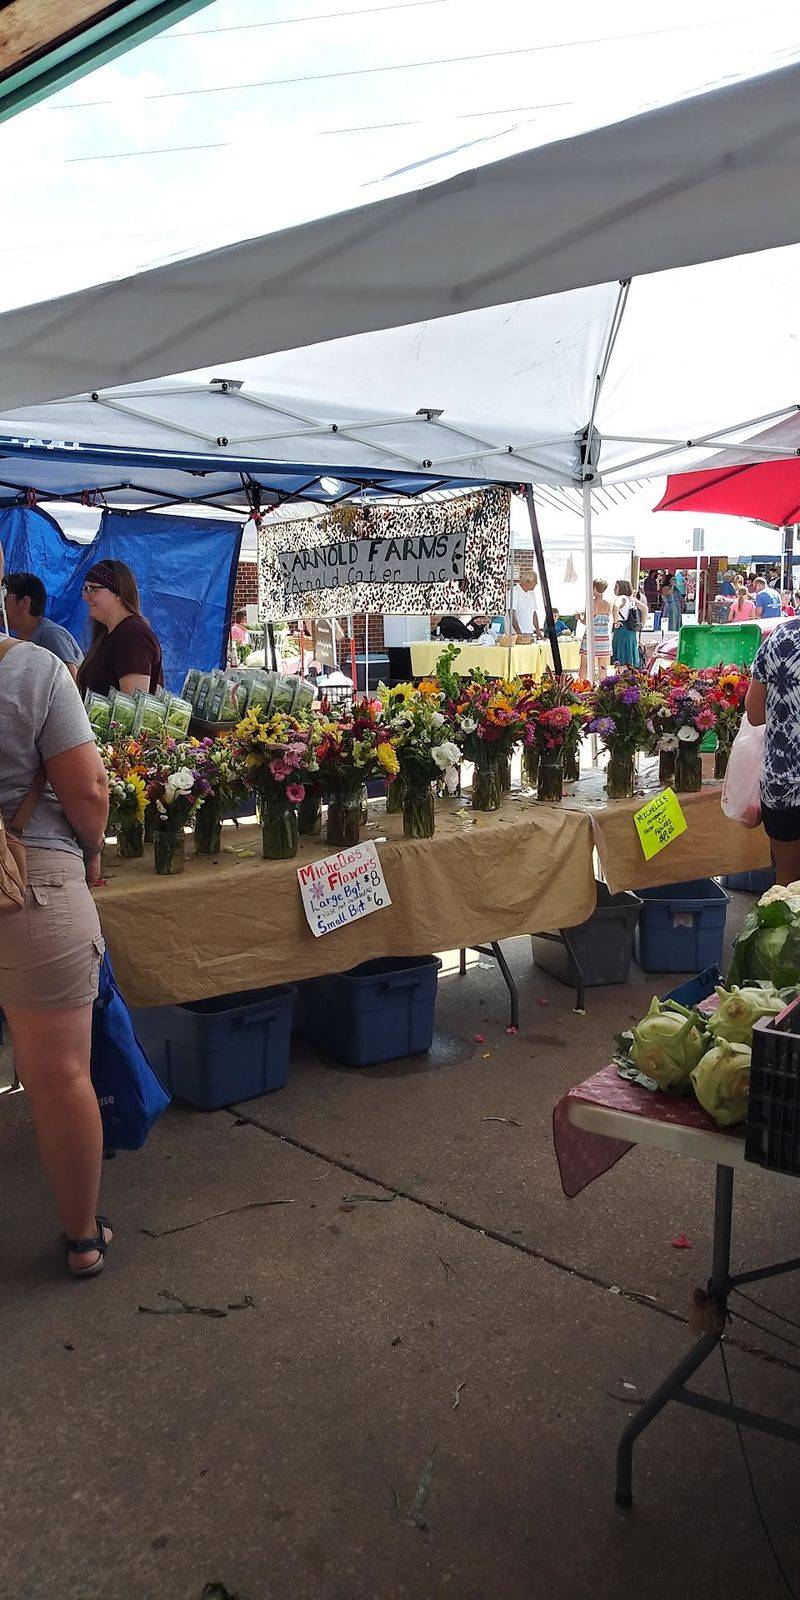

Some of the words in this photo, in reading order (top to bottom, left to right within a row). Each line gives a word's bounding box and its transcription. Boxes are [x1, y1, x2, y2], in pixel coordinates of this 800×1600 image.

[291, 542, 359, 572] ARNOLD
[368, 535, 449, 562] FARMS
[291, 567, 339, 592] Arnold
[299, 849, 363, 886] Michelle's
[310, 893, 343, 913] Large
[364, 869, 381, 887] $8
[317, 912, 347, 934] Small
[366, 892, 384, 907] $6
